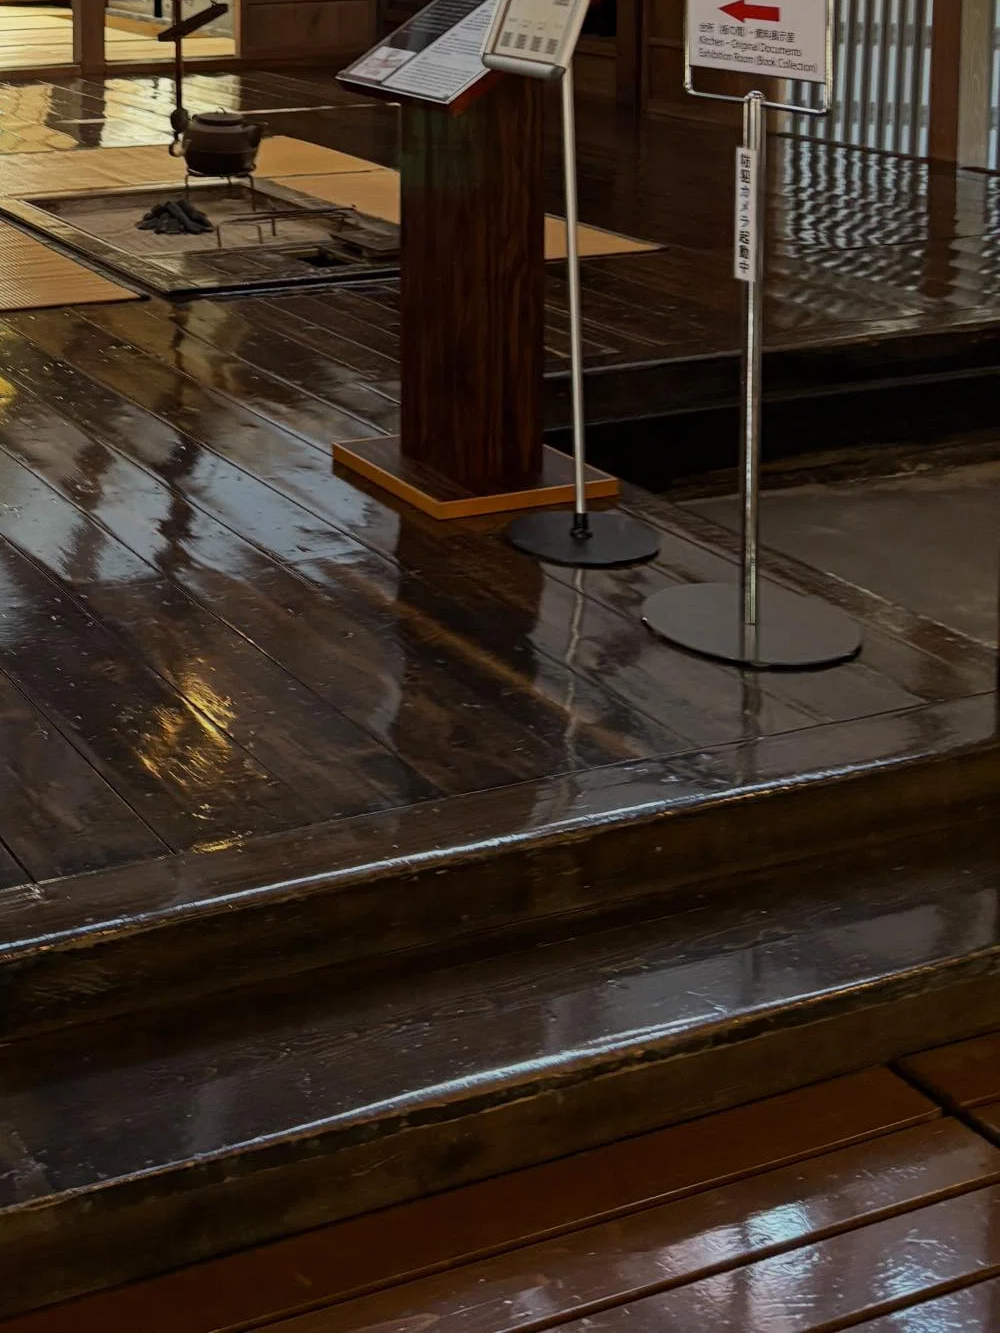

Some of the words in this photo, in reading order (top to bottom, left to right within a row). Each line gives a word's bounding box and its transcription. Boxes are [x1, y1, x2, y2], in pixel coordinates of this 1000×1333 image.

[699, 48, 733, 60] Exhibition
[734, 53, 754, 64] Room
[760, 43, 803, 57] Documents
